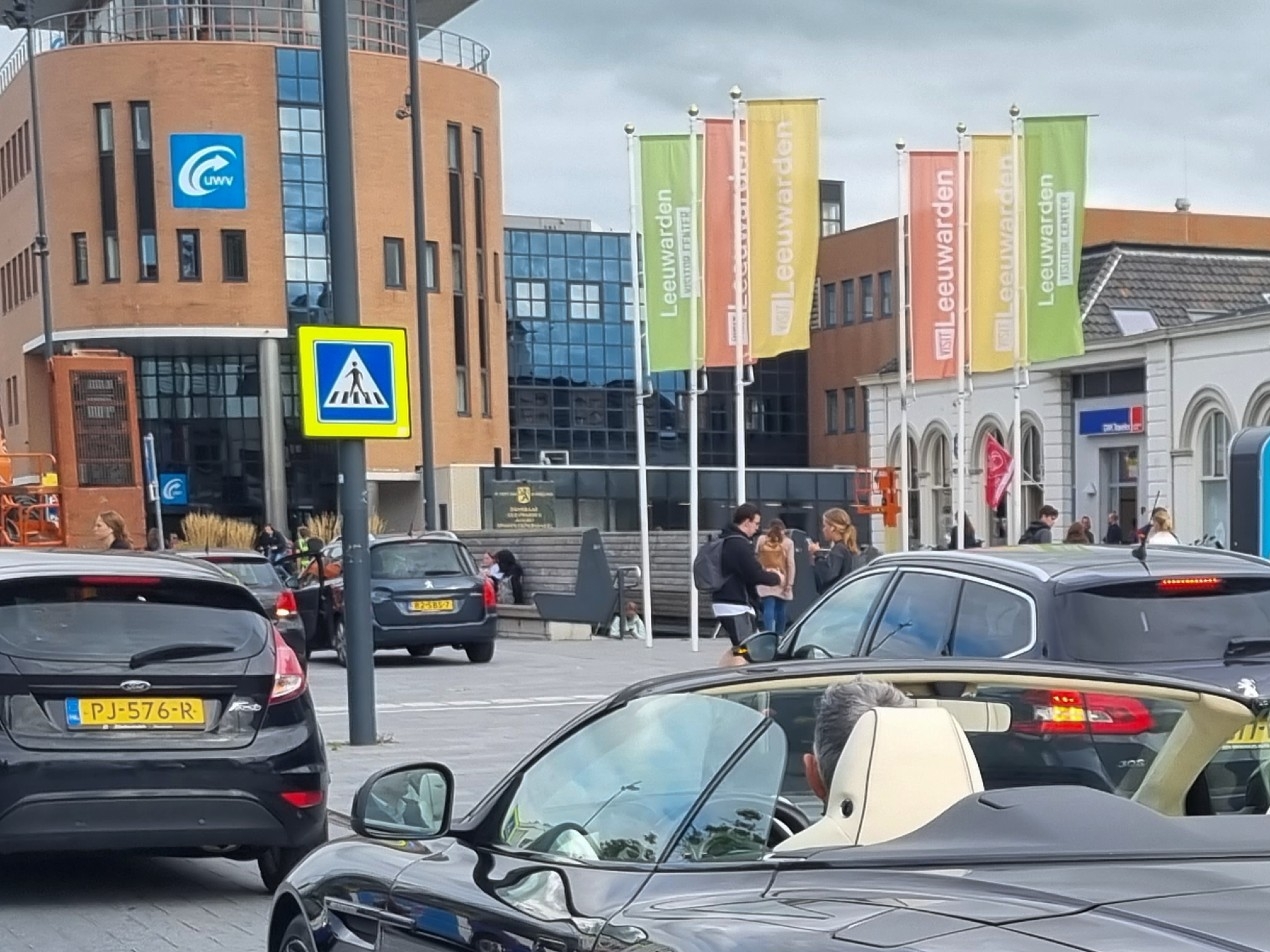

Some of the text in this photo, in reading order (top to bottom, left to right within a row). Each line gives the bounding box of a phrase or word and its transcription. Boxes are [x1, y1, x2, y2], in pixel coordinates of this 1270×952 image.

[654, 189, 678, 317] Leeuwarden
[680, 211, 691, 252] CENTER
[771, 121, 795, 298] Leeuwarden
[932, 170, 955, 357] VISIT Leeuwarden
[995, 155, 1016, 318] Leeuwarden
[1038, 174, 1054, 307] Leeuwarden
[1060, 196, 1071, 281] VISITOR CENTER
[91, 702, 195, 720] PJ-576-R
